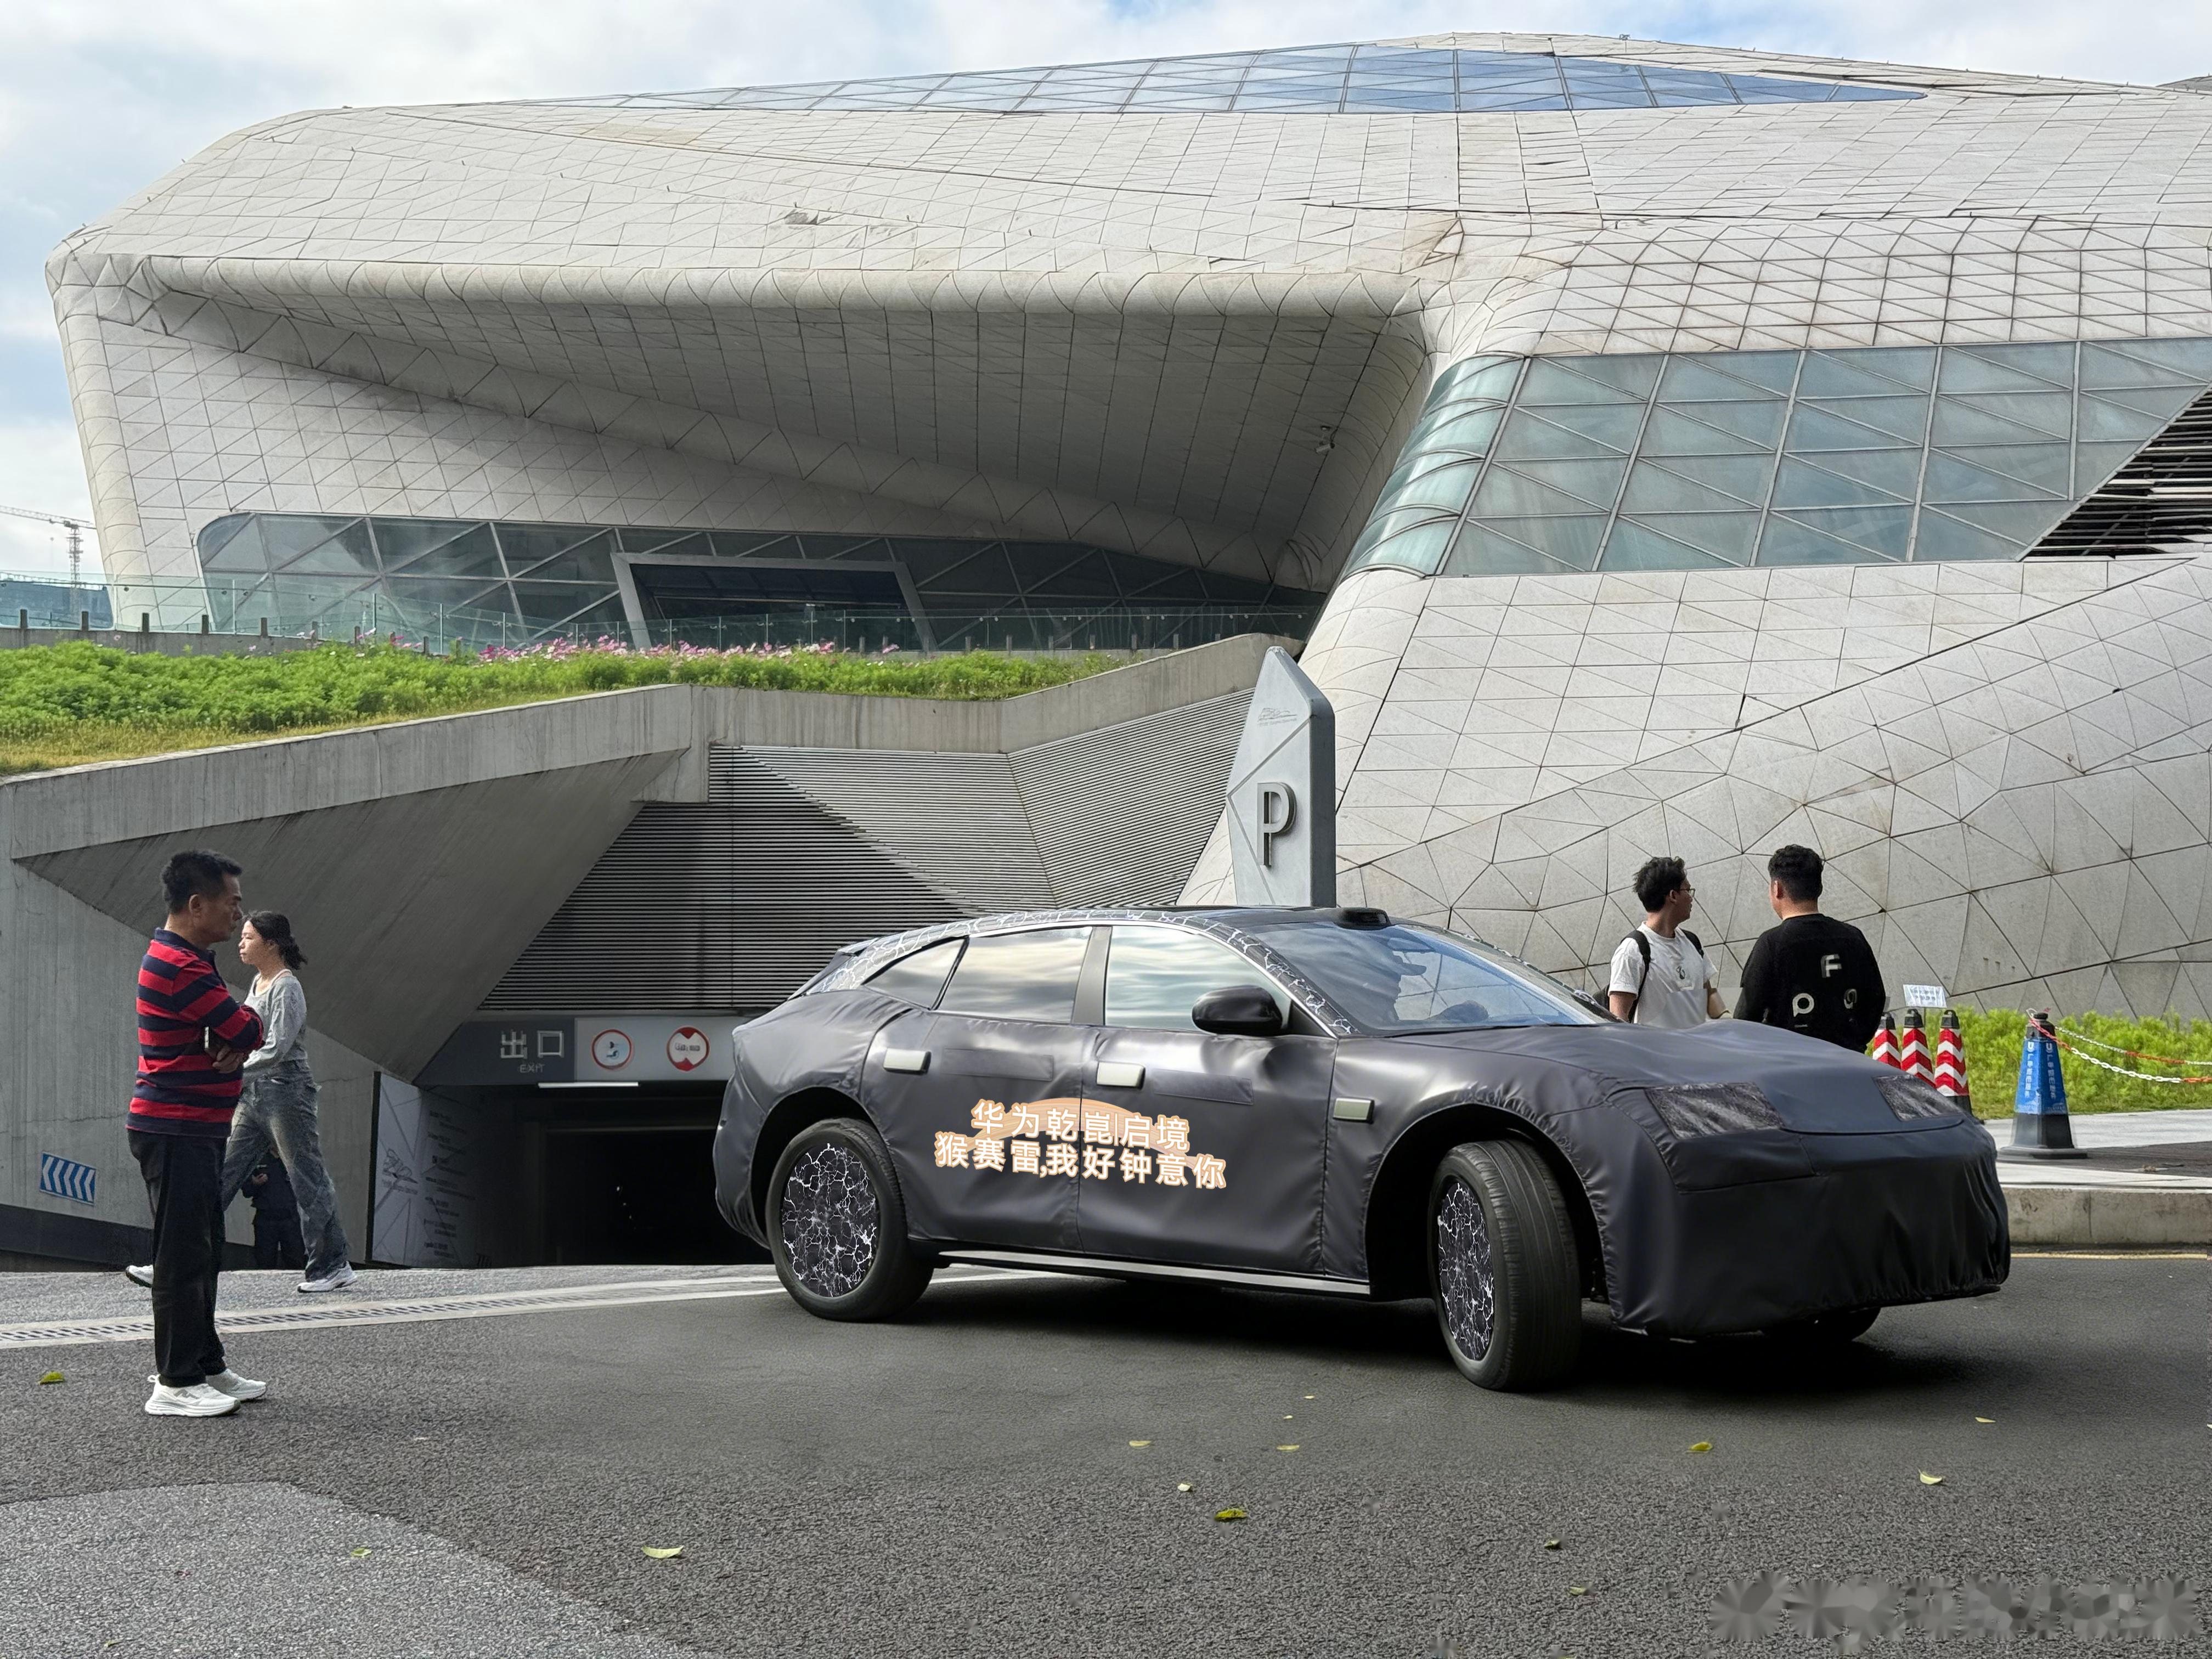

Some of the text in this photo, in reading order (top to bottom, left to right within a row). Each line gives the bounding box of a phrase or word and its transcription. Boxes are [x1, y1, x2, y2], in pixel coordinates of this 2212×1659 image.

[1257, 782, 1297, 867] P
[1821, 954, 1842, 978] F
[500, 1030, 564, 1059] 出口
